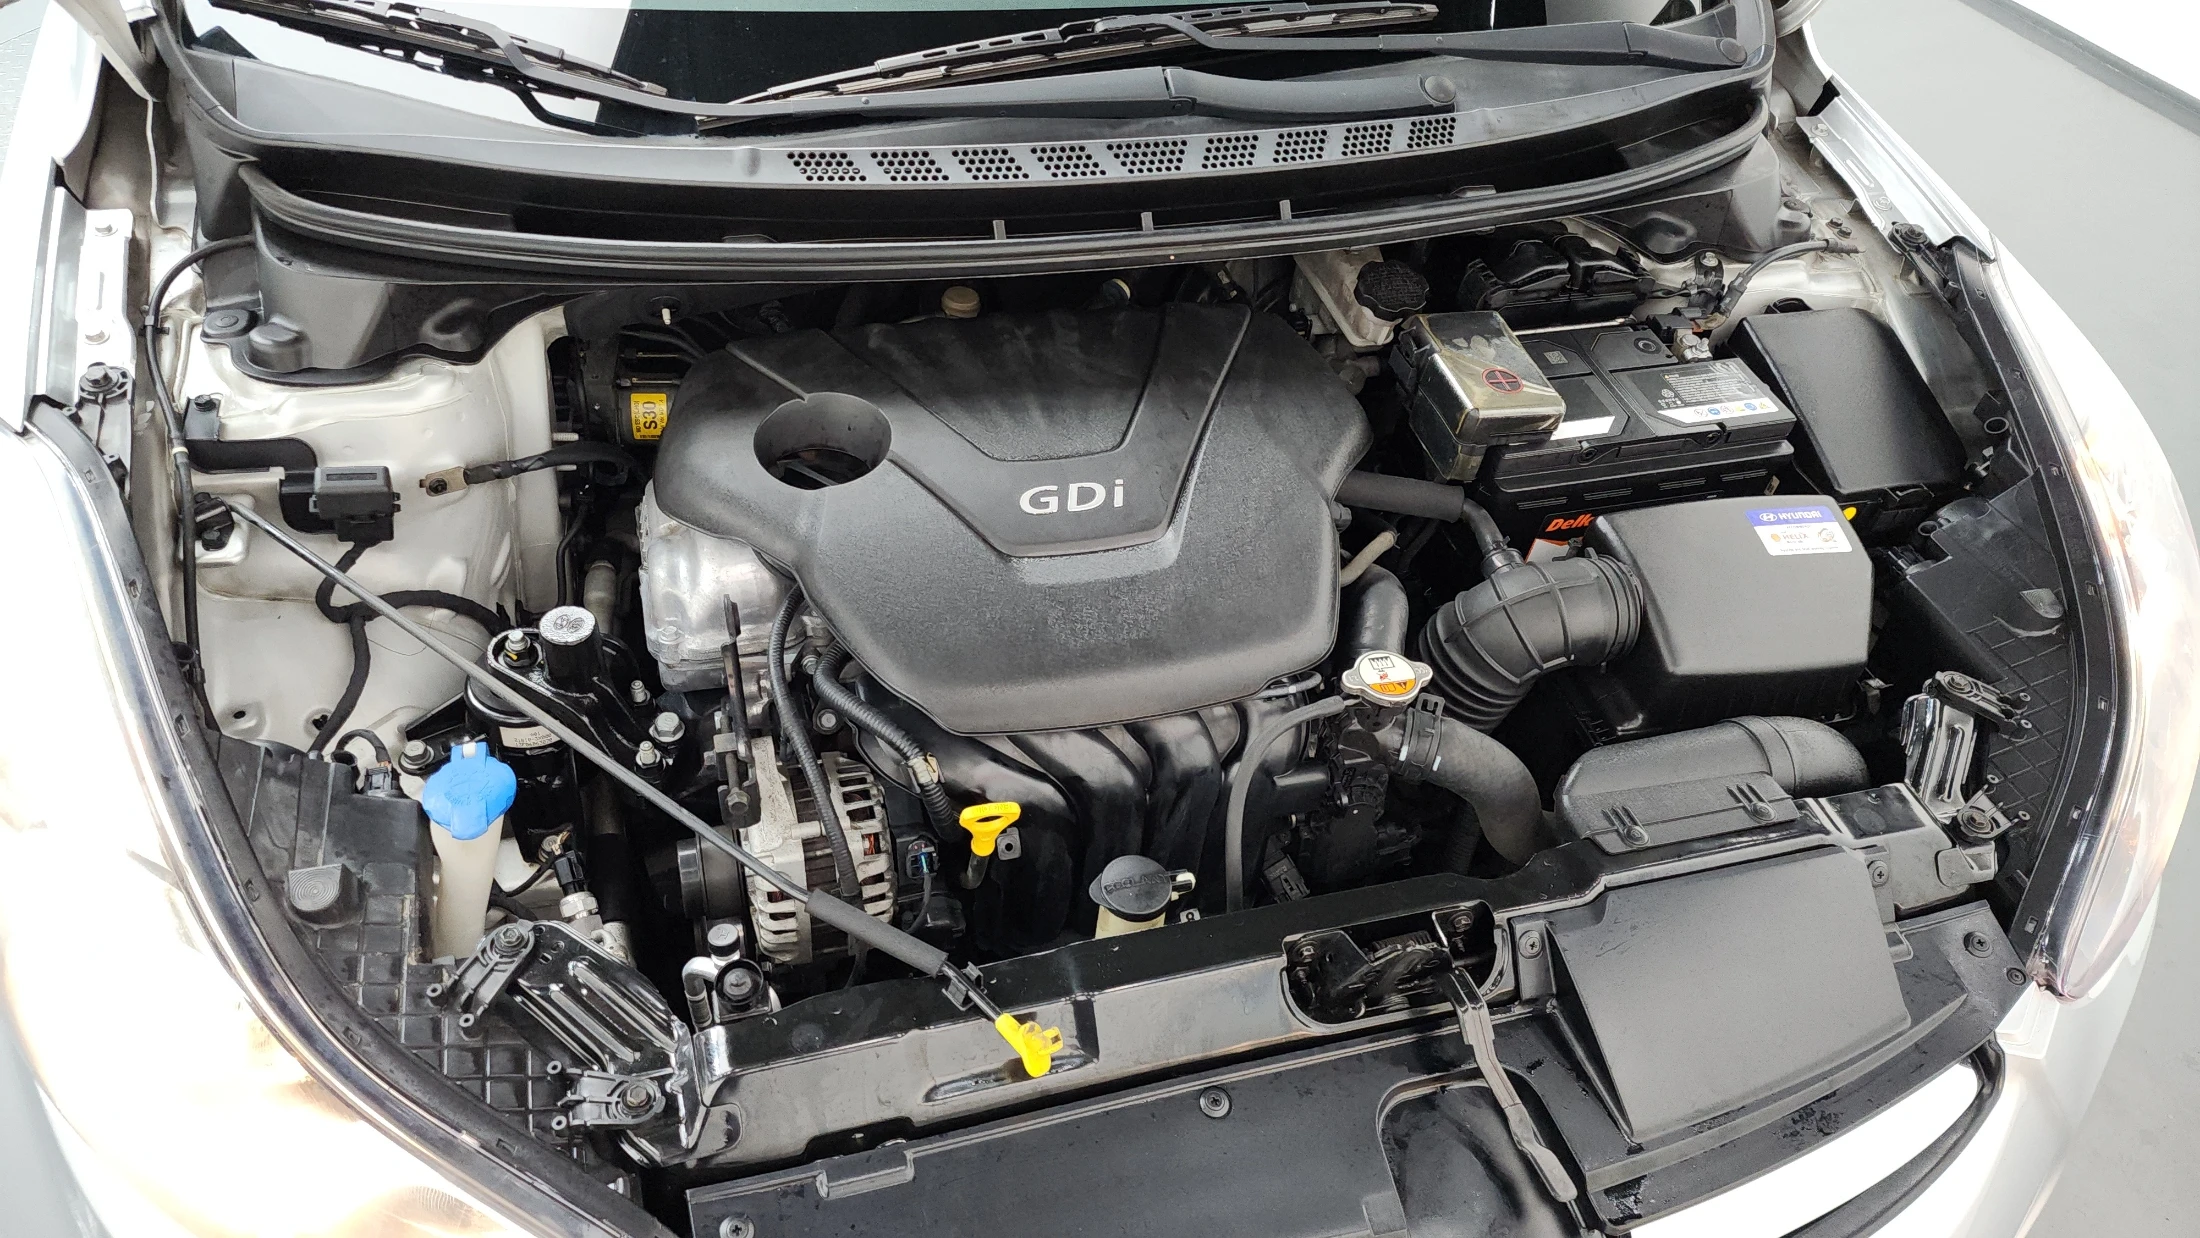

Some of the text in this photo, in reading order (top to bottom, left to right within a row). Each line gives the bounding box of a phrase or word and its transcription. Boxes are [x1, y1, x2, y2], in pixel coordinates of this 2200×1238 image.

[642, 400, 658, 430] S30
[1019, 478, 1124, 515] GDi
[1777, 510, 1822, 520] HYUNDAI
